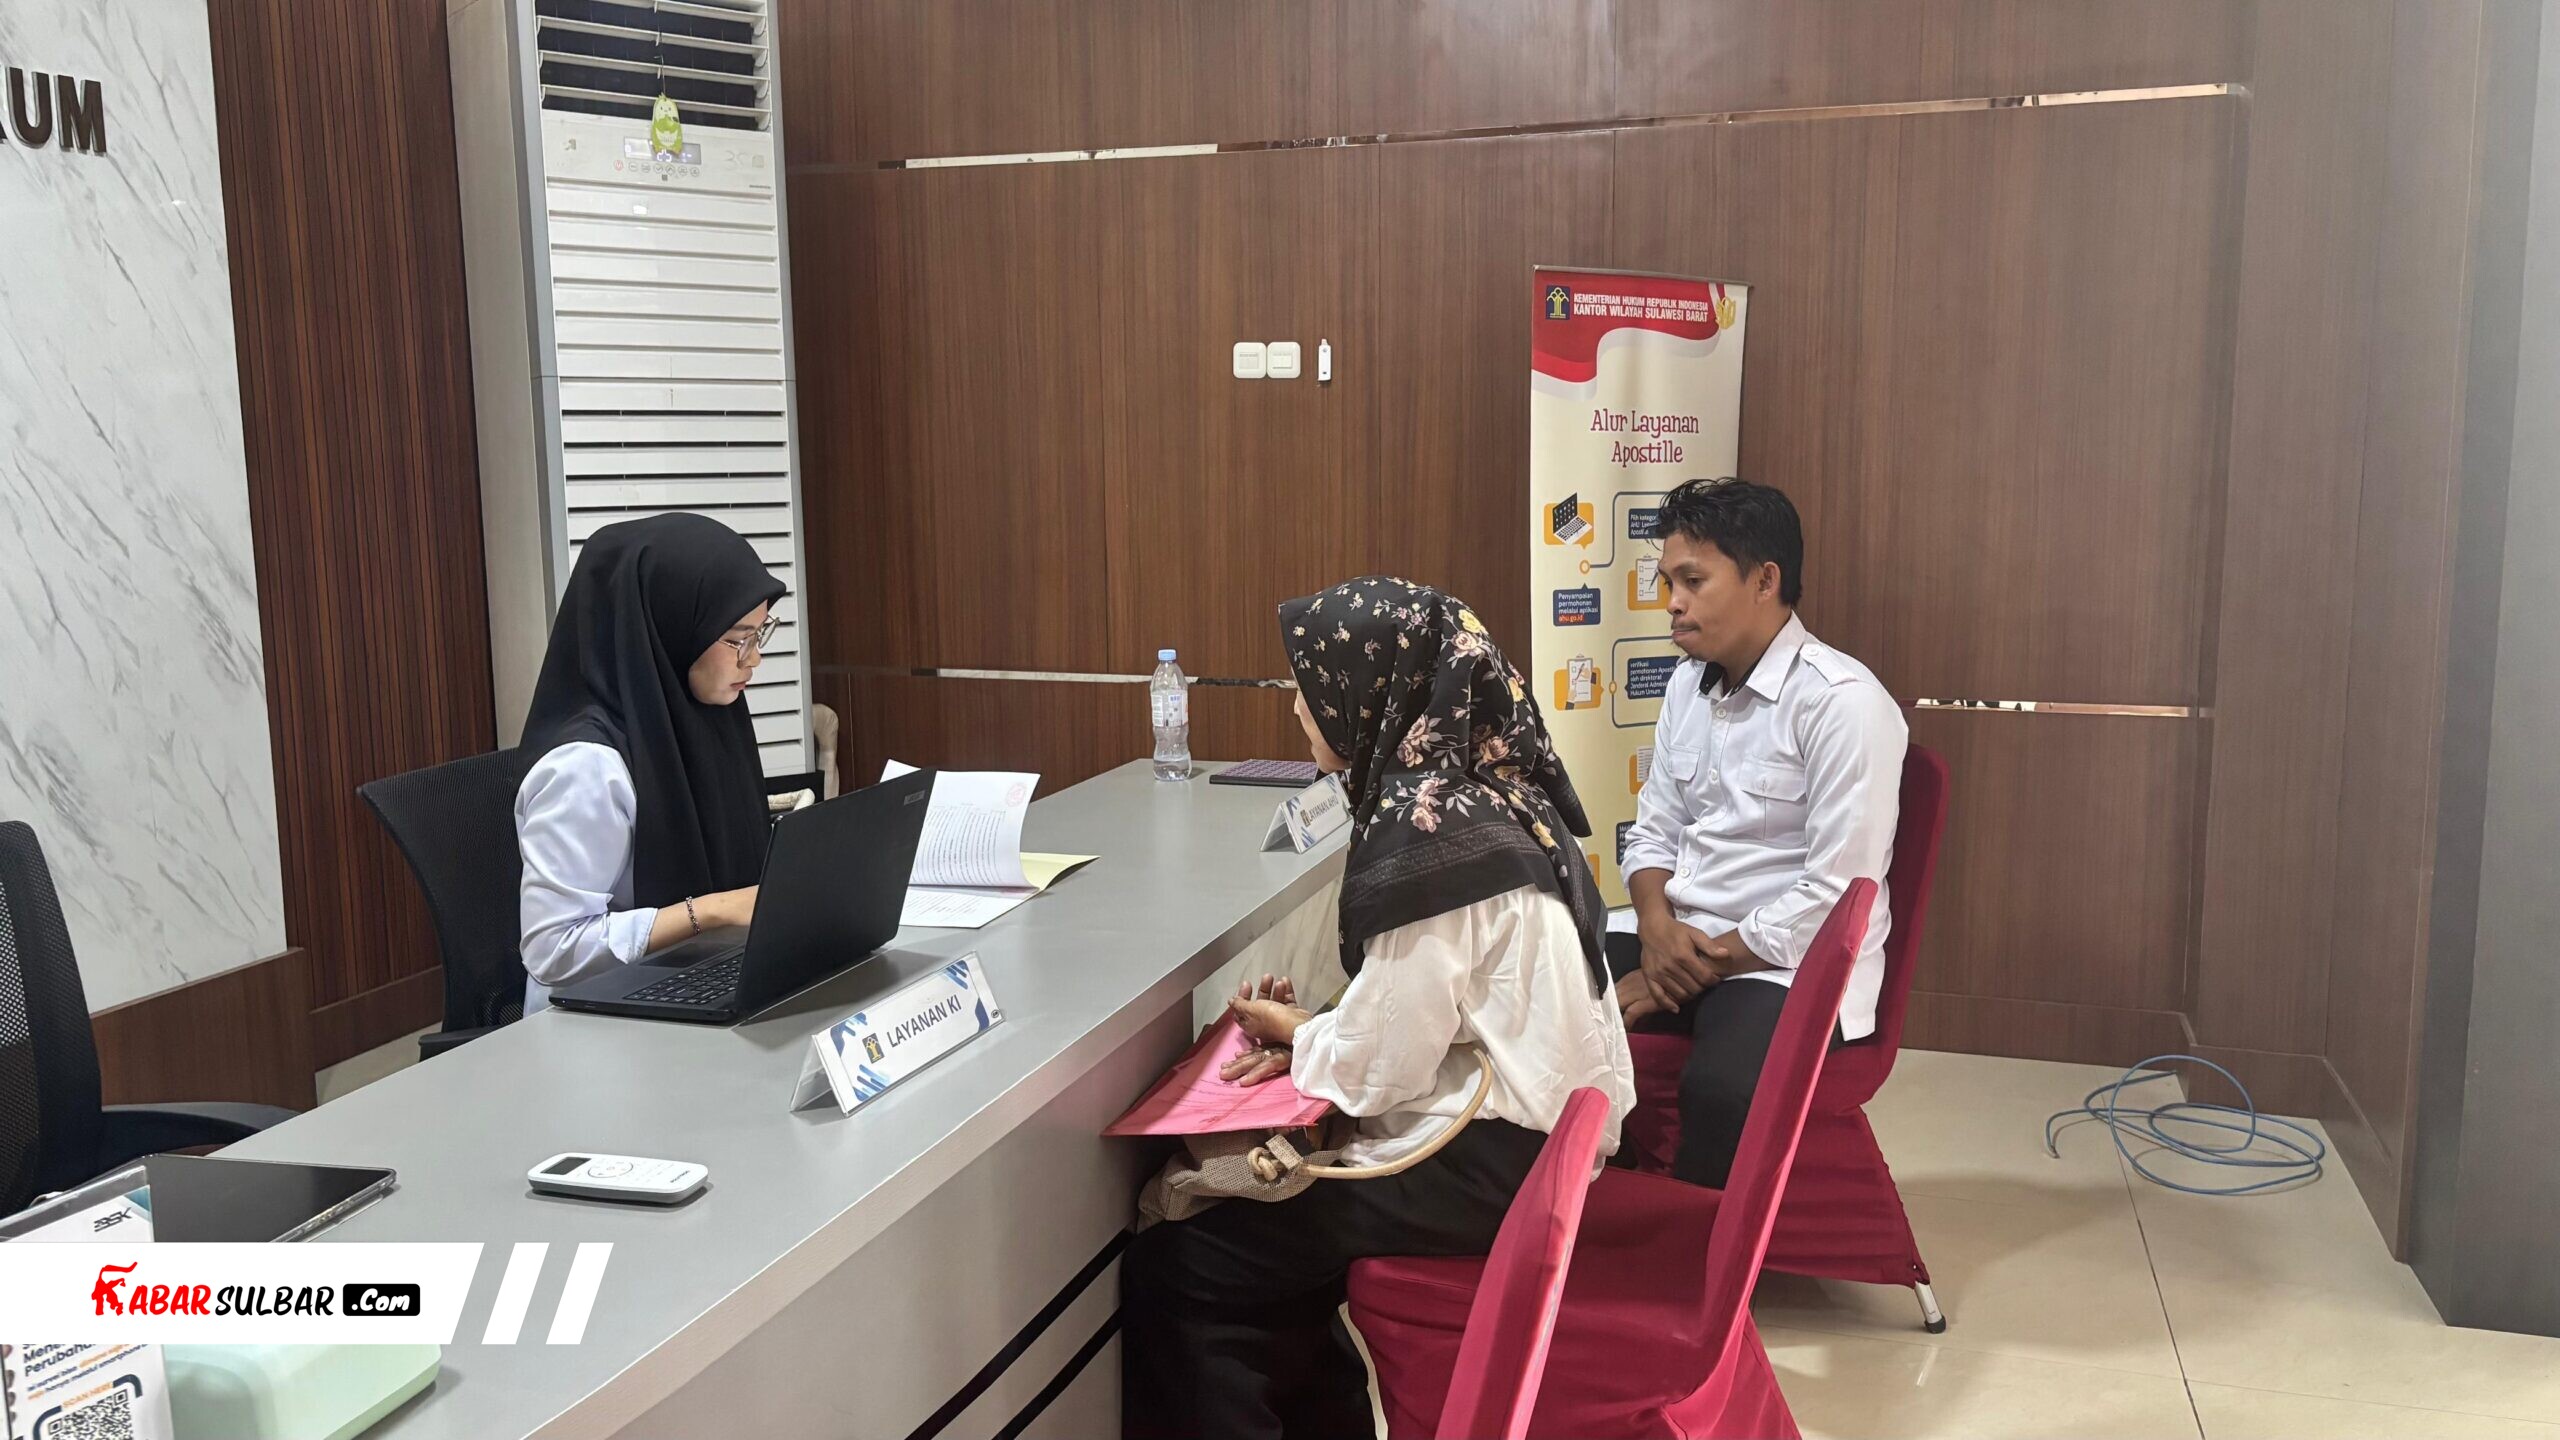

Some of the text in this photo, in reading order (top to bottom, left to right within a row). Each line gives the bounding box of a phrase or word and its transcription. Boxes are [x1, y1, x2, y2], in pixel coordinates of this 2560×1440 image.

[0, 66, 107, 157] UM
[1573, 293, 1708, 311] KEMENTERIAN HUKUM REPUBLIK INDONESIA
[1573, 304, 1708, 323] KANTOR WILAYAH SULAWESI BARAT
[1590, 408, 1700, 438] Alur Layanan
[1611, 440, 1683, 468] Apostille
[1558, 593, 1594, 601] Penyampaian
[1579, 607, 1599, 615] aplikasi
[887, 994, 962, 1048] LAYANAN KI
[24, 1344, 65, 1363] Mene
[25, 1344, 96, 1377] Perubaha
